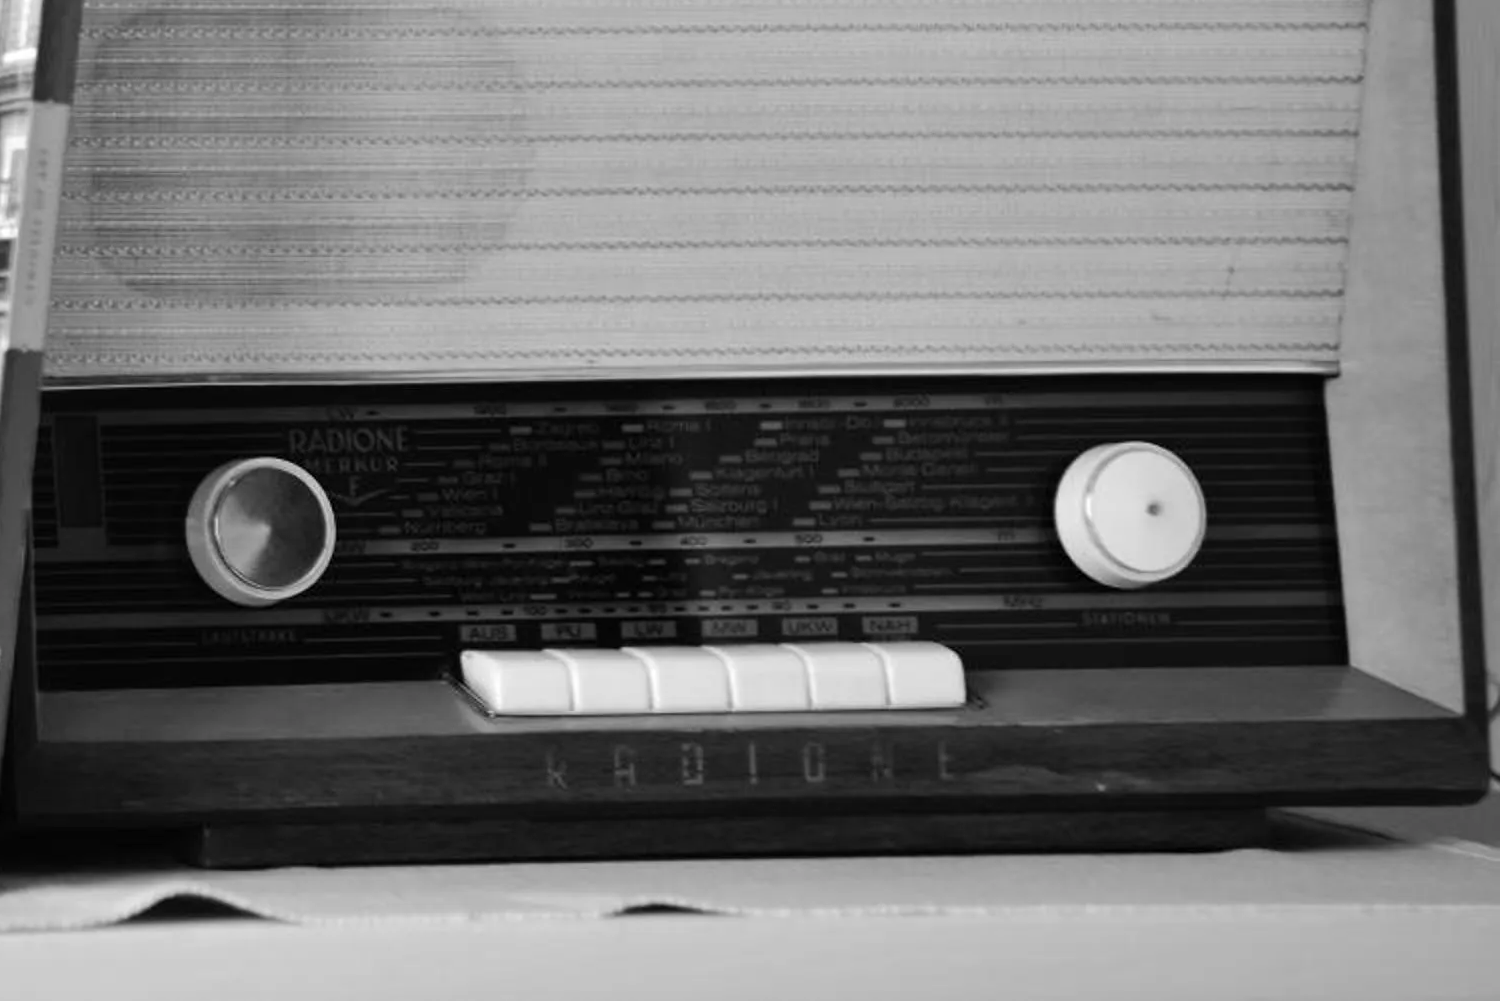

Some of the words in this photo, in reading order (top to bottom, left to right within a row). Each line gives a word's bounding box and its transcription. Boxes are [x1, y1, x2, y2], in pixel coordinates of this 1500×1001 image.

[289, 426, 411, 453] RADIONE
[302, 457, 399, 473] MERKUR
[794, 532, 823, 546] 500
[787, 619, 834, 633] UKW
